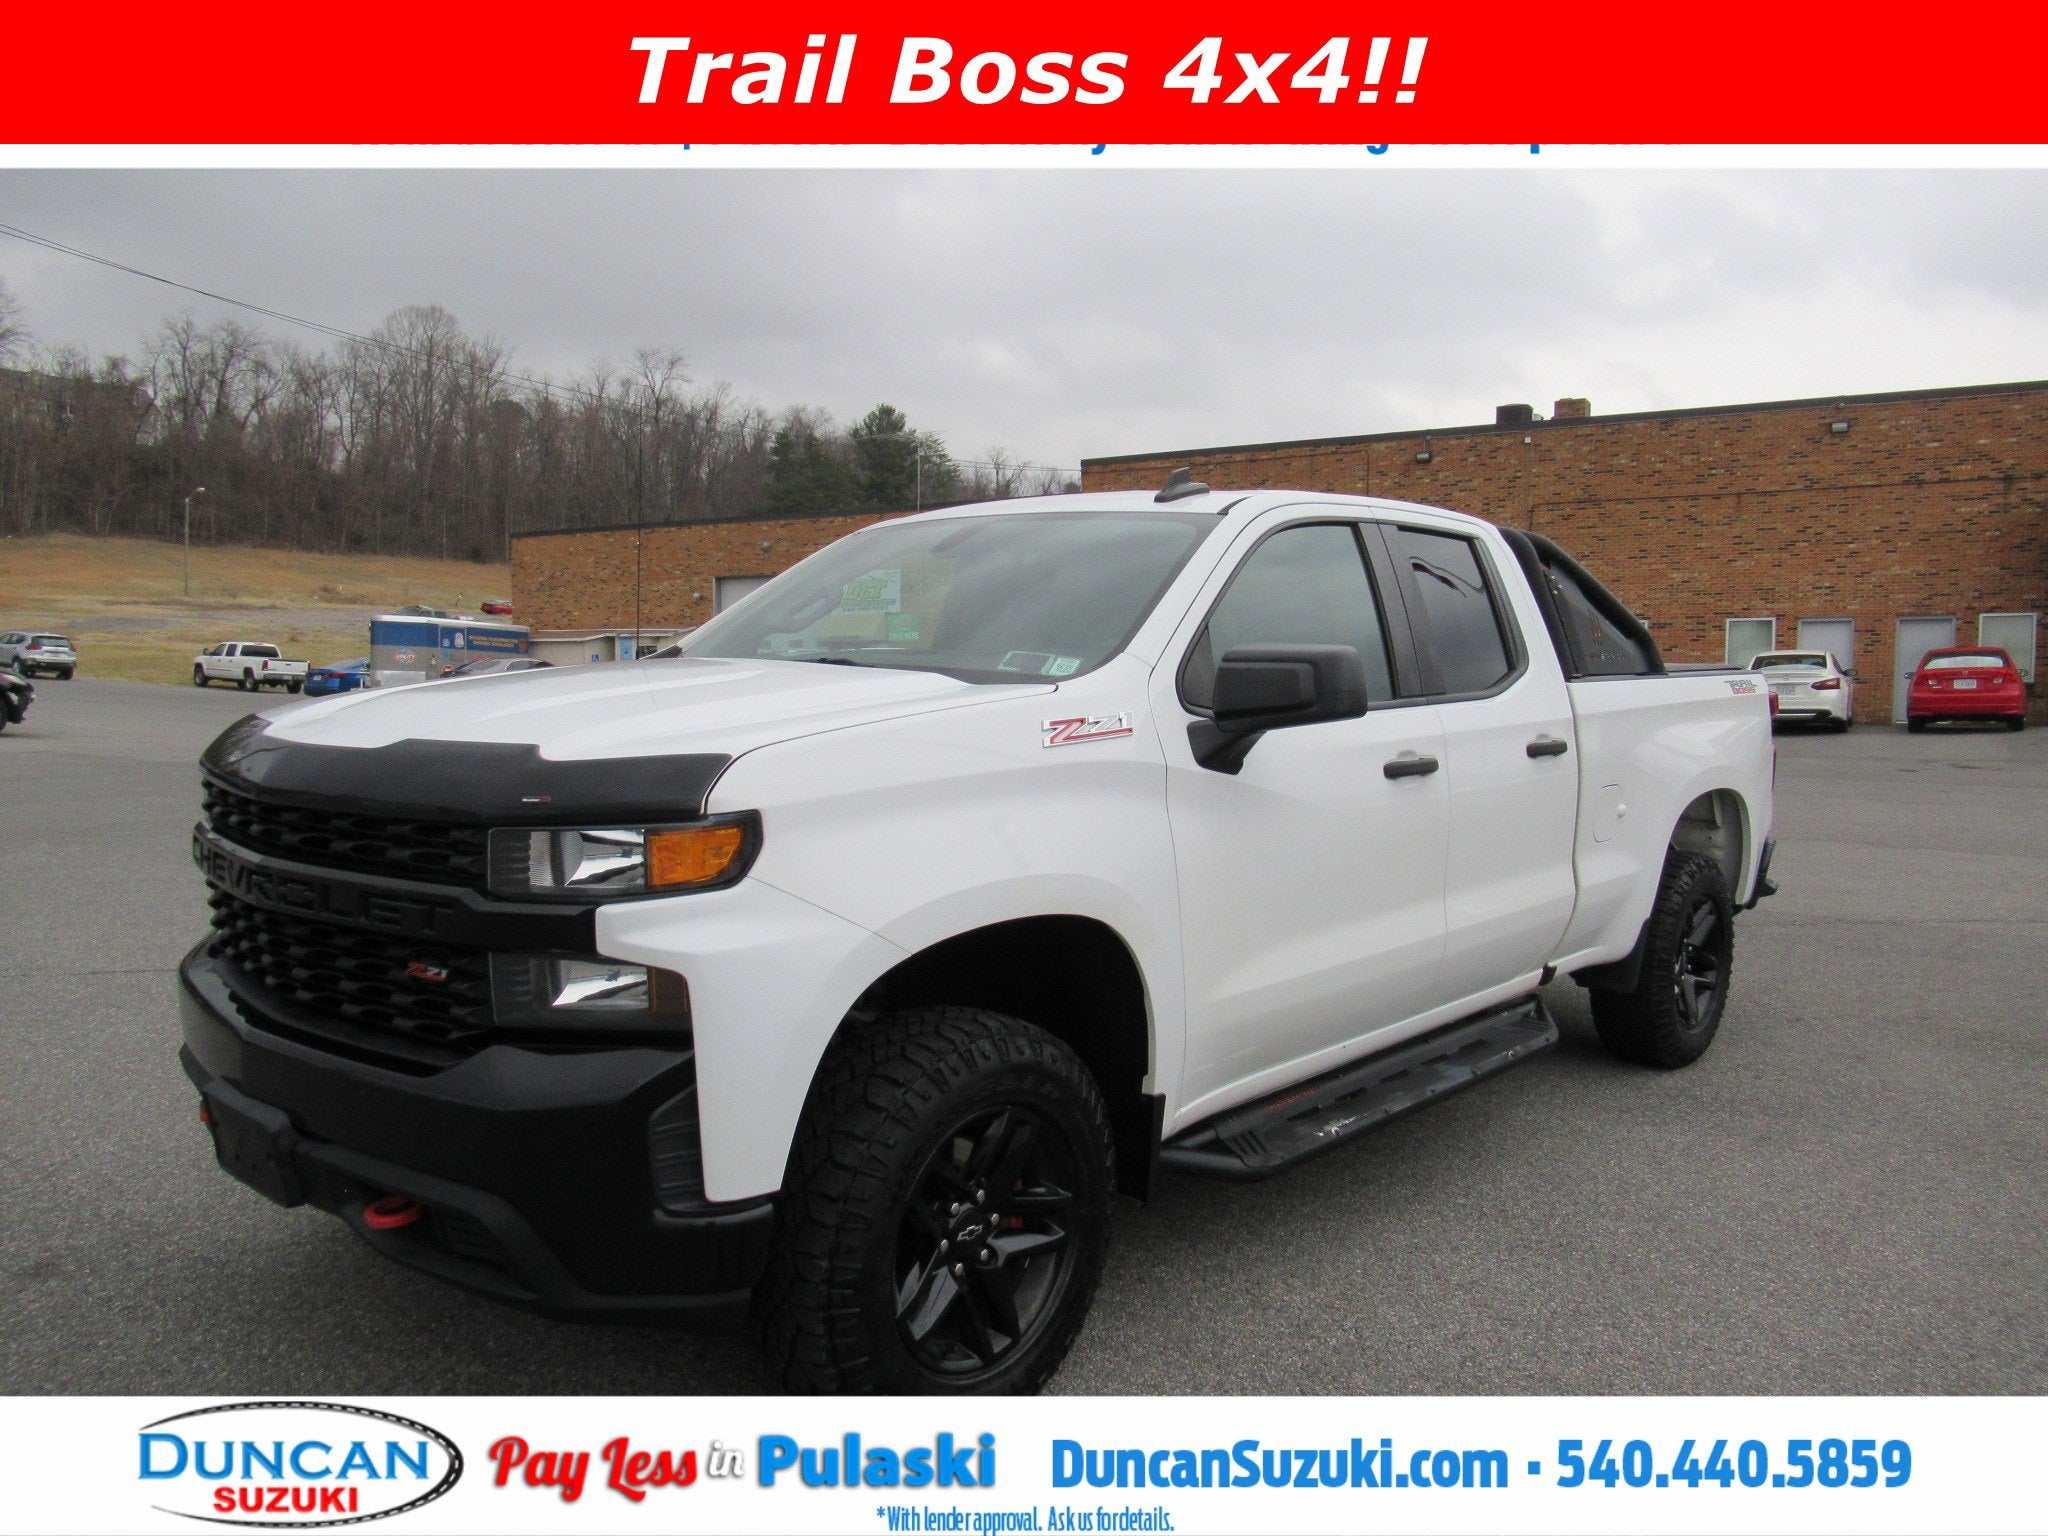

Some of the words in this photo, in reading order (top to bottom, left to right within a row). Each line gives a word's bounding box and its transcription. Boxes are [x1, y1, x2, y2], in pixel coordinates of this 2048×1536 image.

[1724, 679, 1757, 689] TRAIL
[1732, 686, 1758, 694] BOSS
[1041, 711, 1134, 748] Z71
[405, 960, 449, 982] Z71
